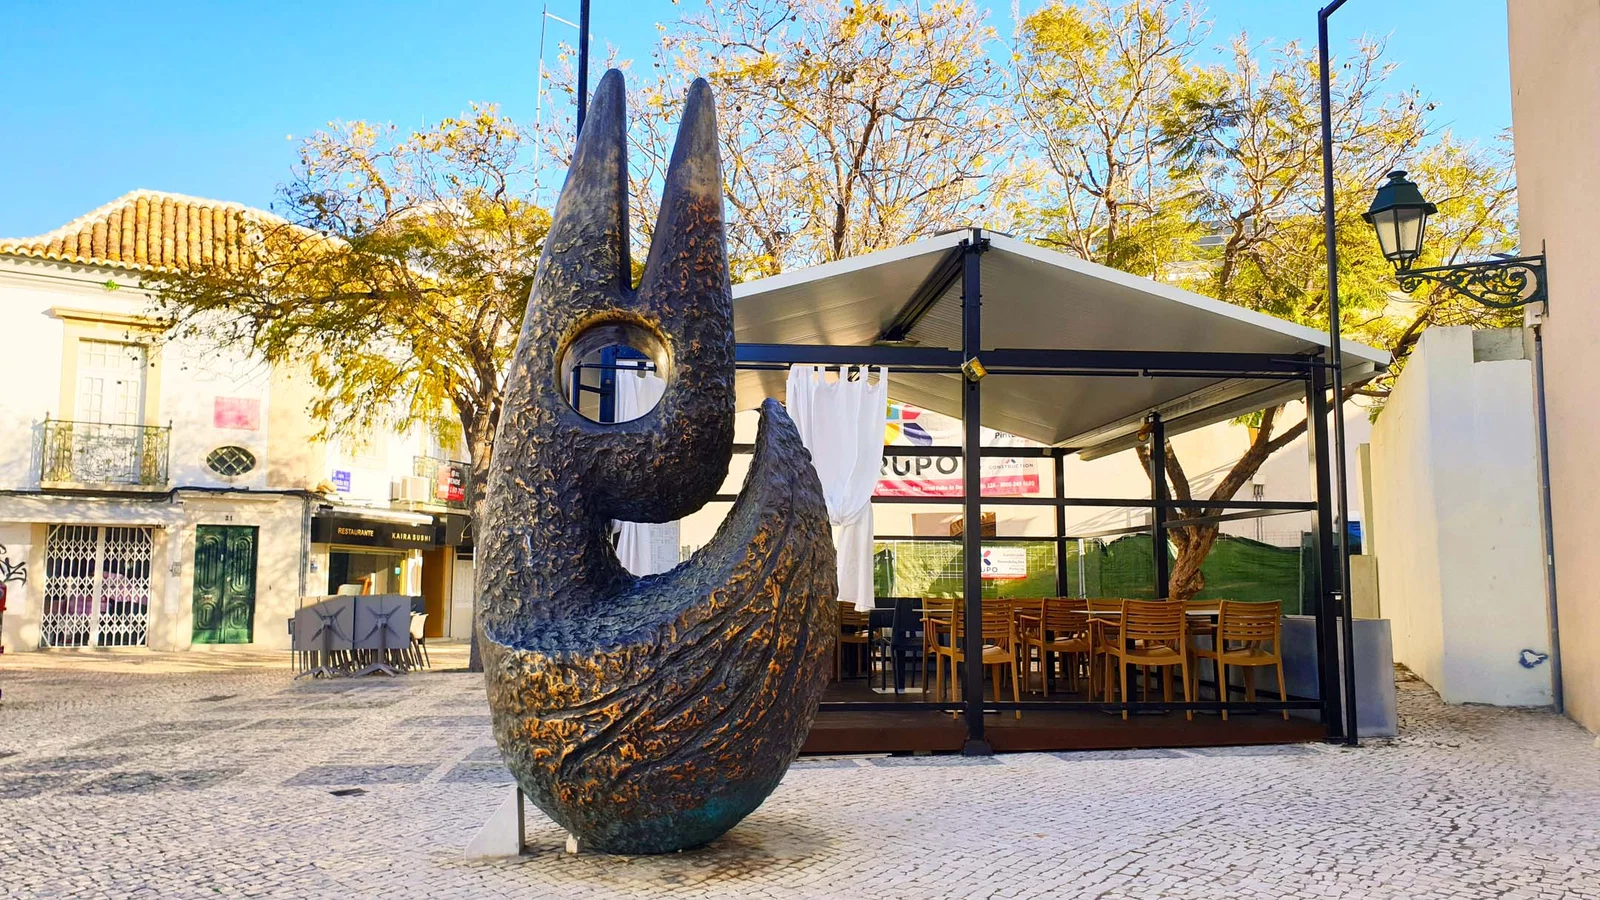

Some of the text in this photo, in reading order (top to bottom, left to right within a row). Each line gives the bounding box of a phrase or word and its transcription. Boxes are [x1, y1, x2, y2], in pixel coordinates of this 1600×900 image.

[337, 527, 374, 537] RESTAURANTE
[391, 532, 431, 542] KAIRA SUSHI
